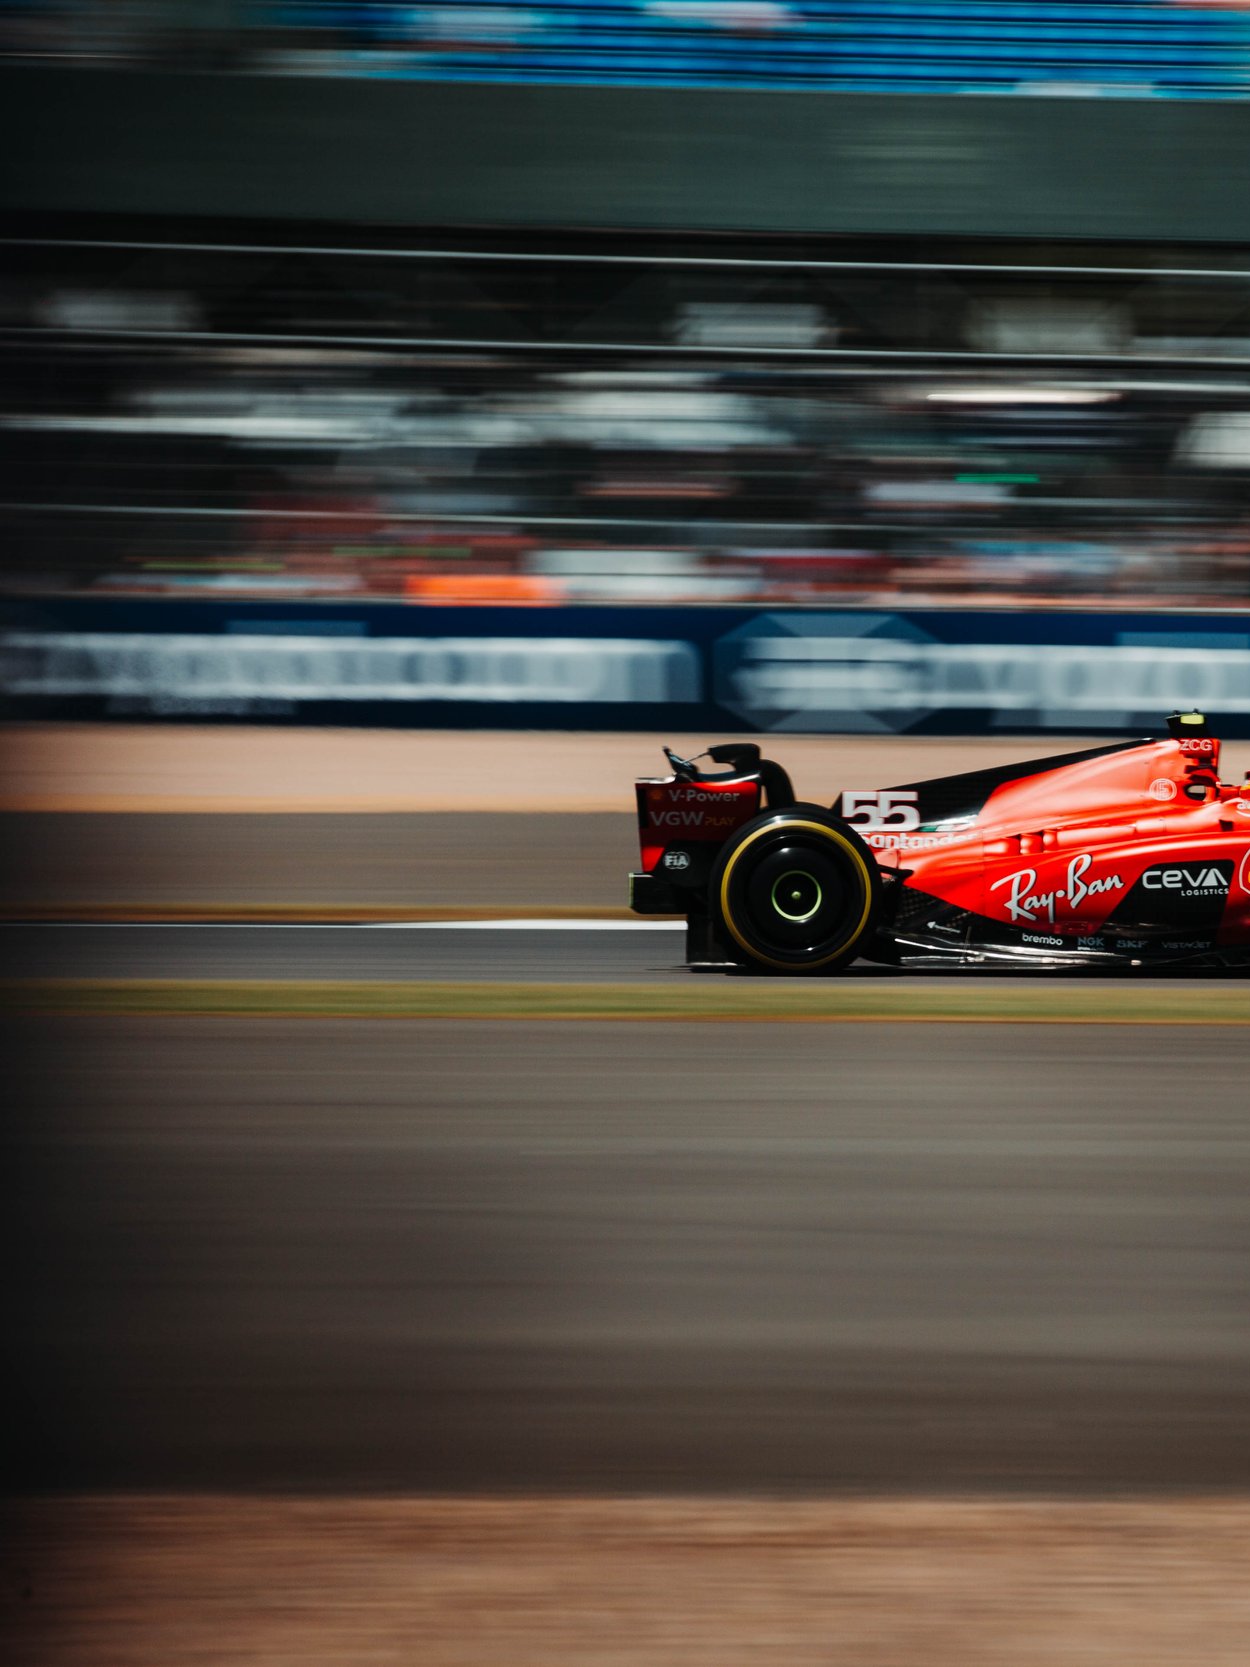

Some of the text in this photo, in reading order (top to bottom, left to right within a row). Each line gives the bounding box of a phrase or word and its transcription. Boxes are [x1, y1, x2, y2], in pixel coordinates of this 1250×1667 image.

[1180, 739, 1213, 751] ZCG
[668, 789, 740, 802] V-Power
[841, 790, 921, 832] 55
[650, 811, 704, 827] VGW
[1181, 888, 1230, 897] LOGISTICS
[1022, 933, 1063, 946] brembo
[1077, 936, 1105, 947] NGK
